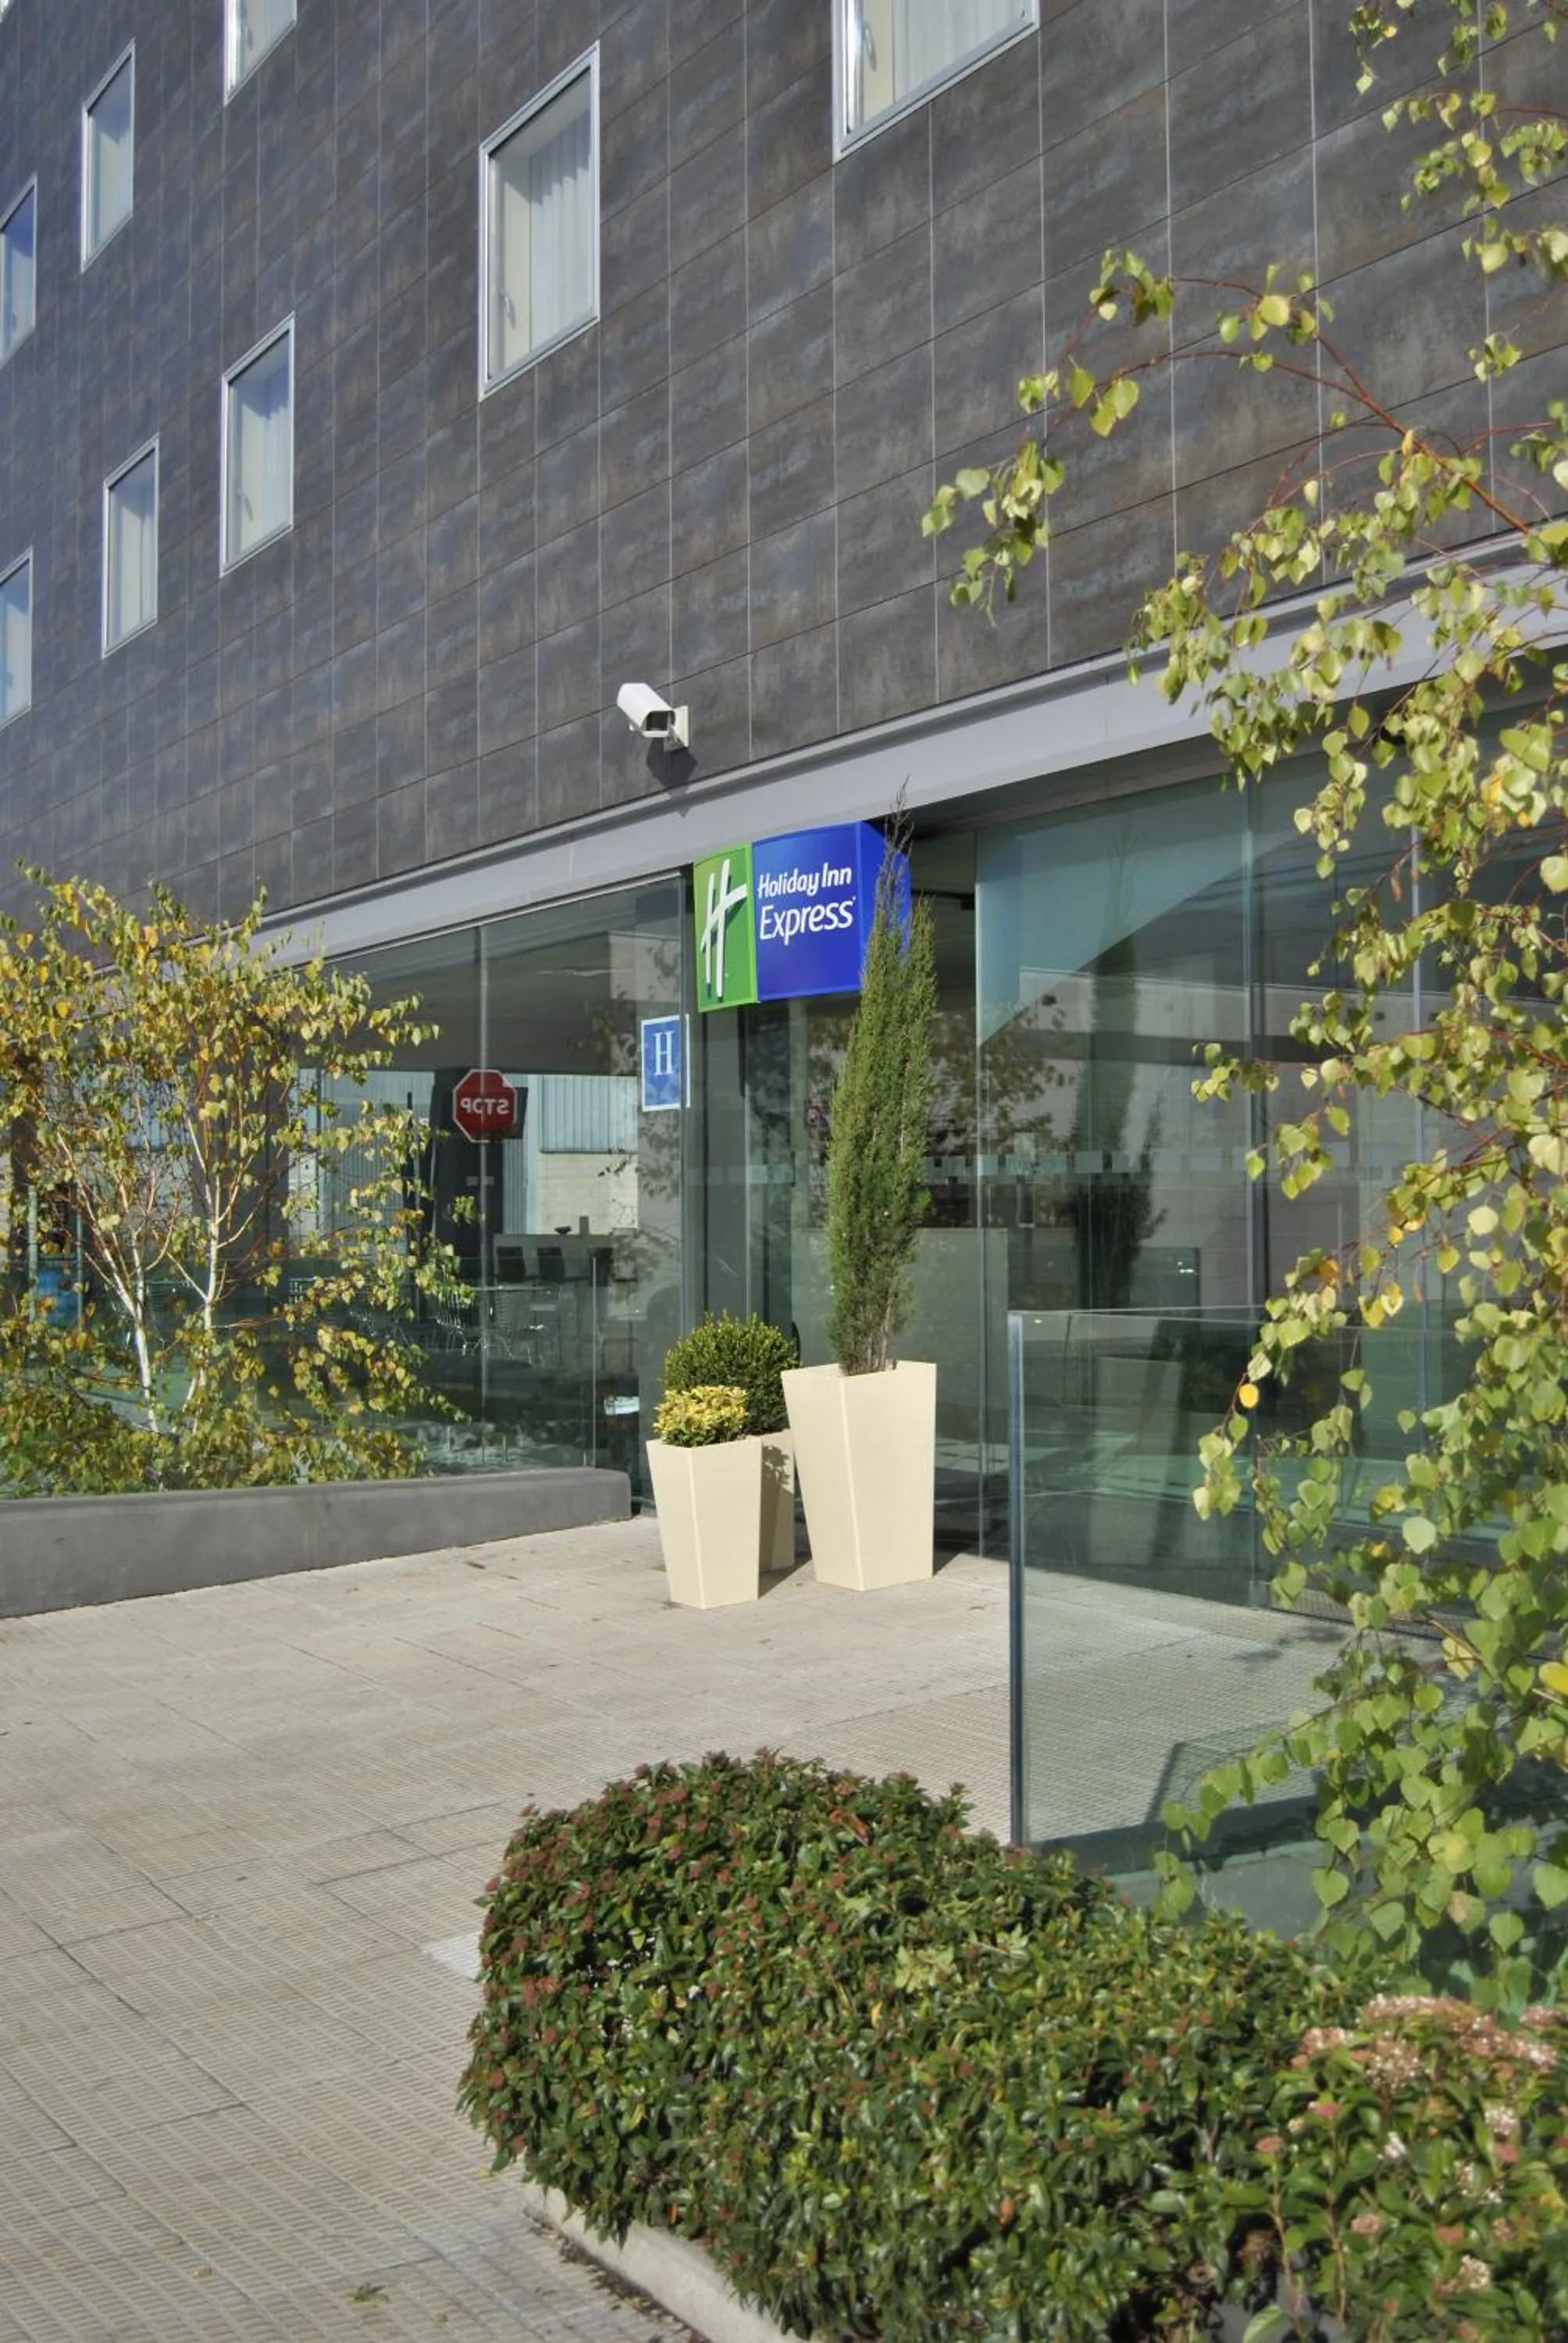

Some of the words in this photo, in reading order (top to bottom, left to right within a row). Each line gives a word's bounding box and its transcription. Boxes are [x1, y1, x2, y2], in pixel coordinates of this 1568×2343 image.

[757, 868, 820, 899] Holiday
[821, 861, 852, 887] Inn
[760, 900, 854, 946] Express
[653, 1030, 675, 1075] H
